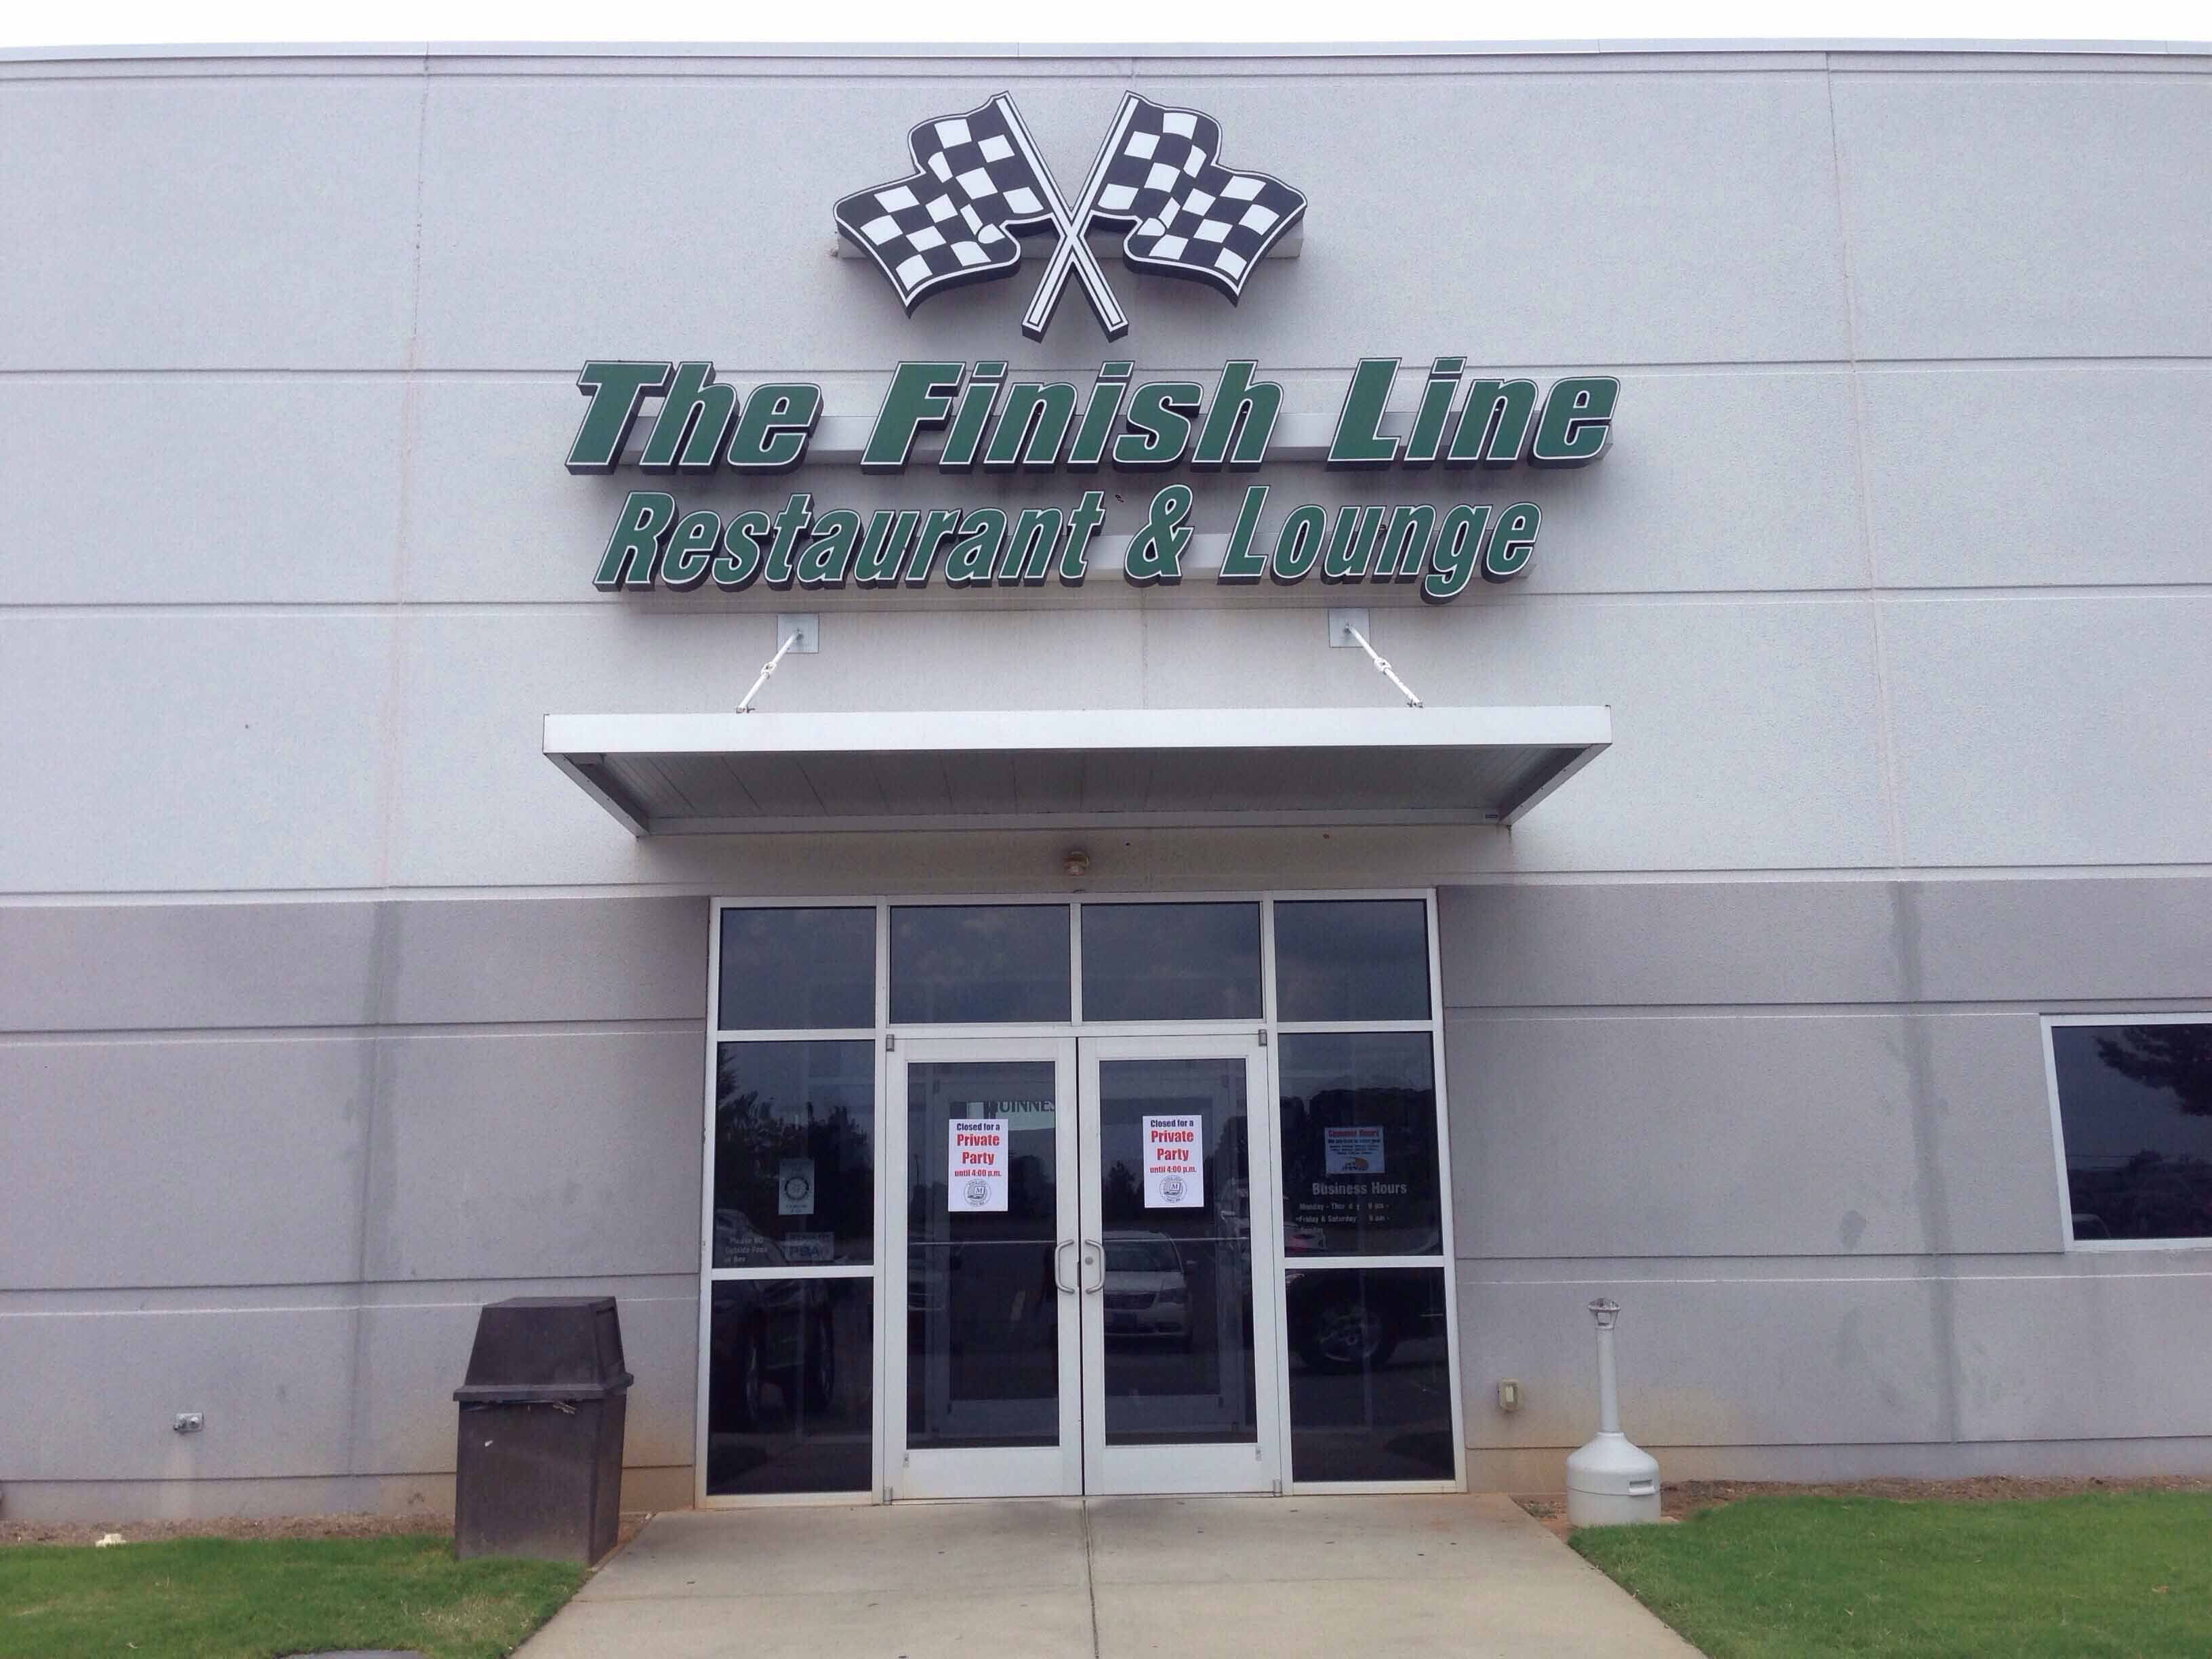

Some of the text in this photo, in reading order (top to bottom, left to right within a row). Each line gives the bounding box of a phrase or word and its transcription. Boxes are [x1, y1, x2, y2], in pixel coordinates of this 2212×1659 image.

[565, 356, 1620, 471] The Finish Line
[592, 484, 1542, 601] Restaurant & Lounge
[956, 1123, 982, 1131] Closed
[983, 1123, 994, 1131] for
[1150, 1119, 1176, 1128] Closed
[1177, 1119, 1188, 1127] for
[957, 1133, 1000, 1146] Private
[1151, 1130, 1194, 1143] Private
[962, 1151, 994, 1165] Party
[1157, 1148, 1189, 1161] Party
[954, 1169, 1002, 1179] until 4:00 p.m.
[1183, 1166, 1197, 1174] p.m.
[1312, 1181, 1408, 1195] Business Hours
[1328, 1214, 1356, 1224] Saturday
